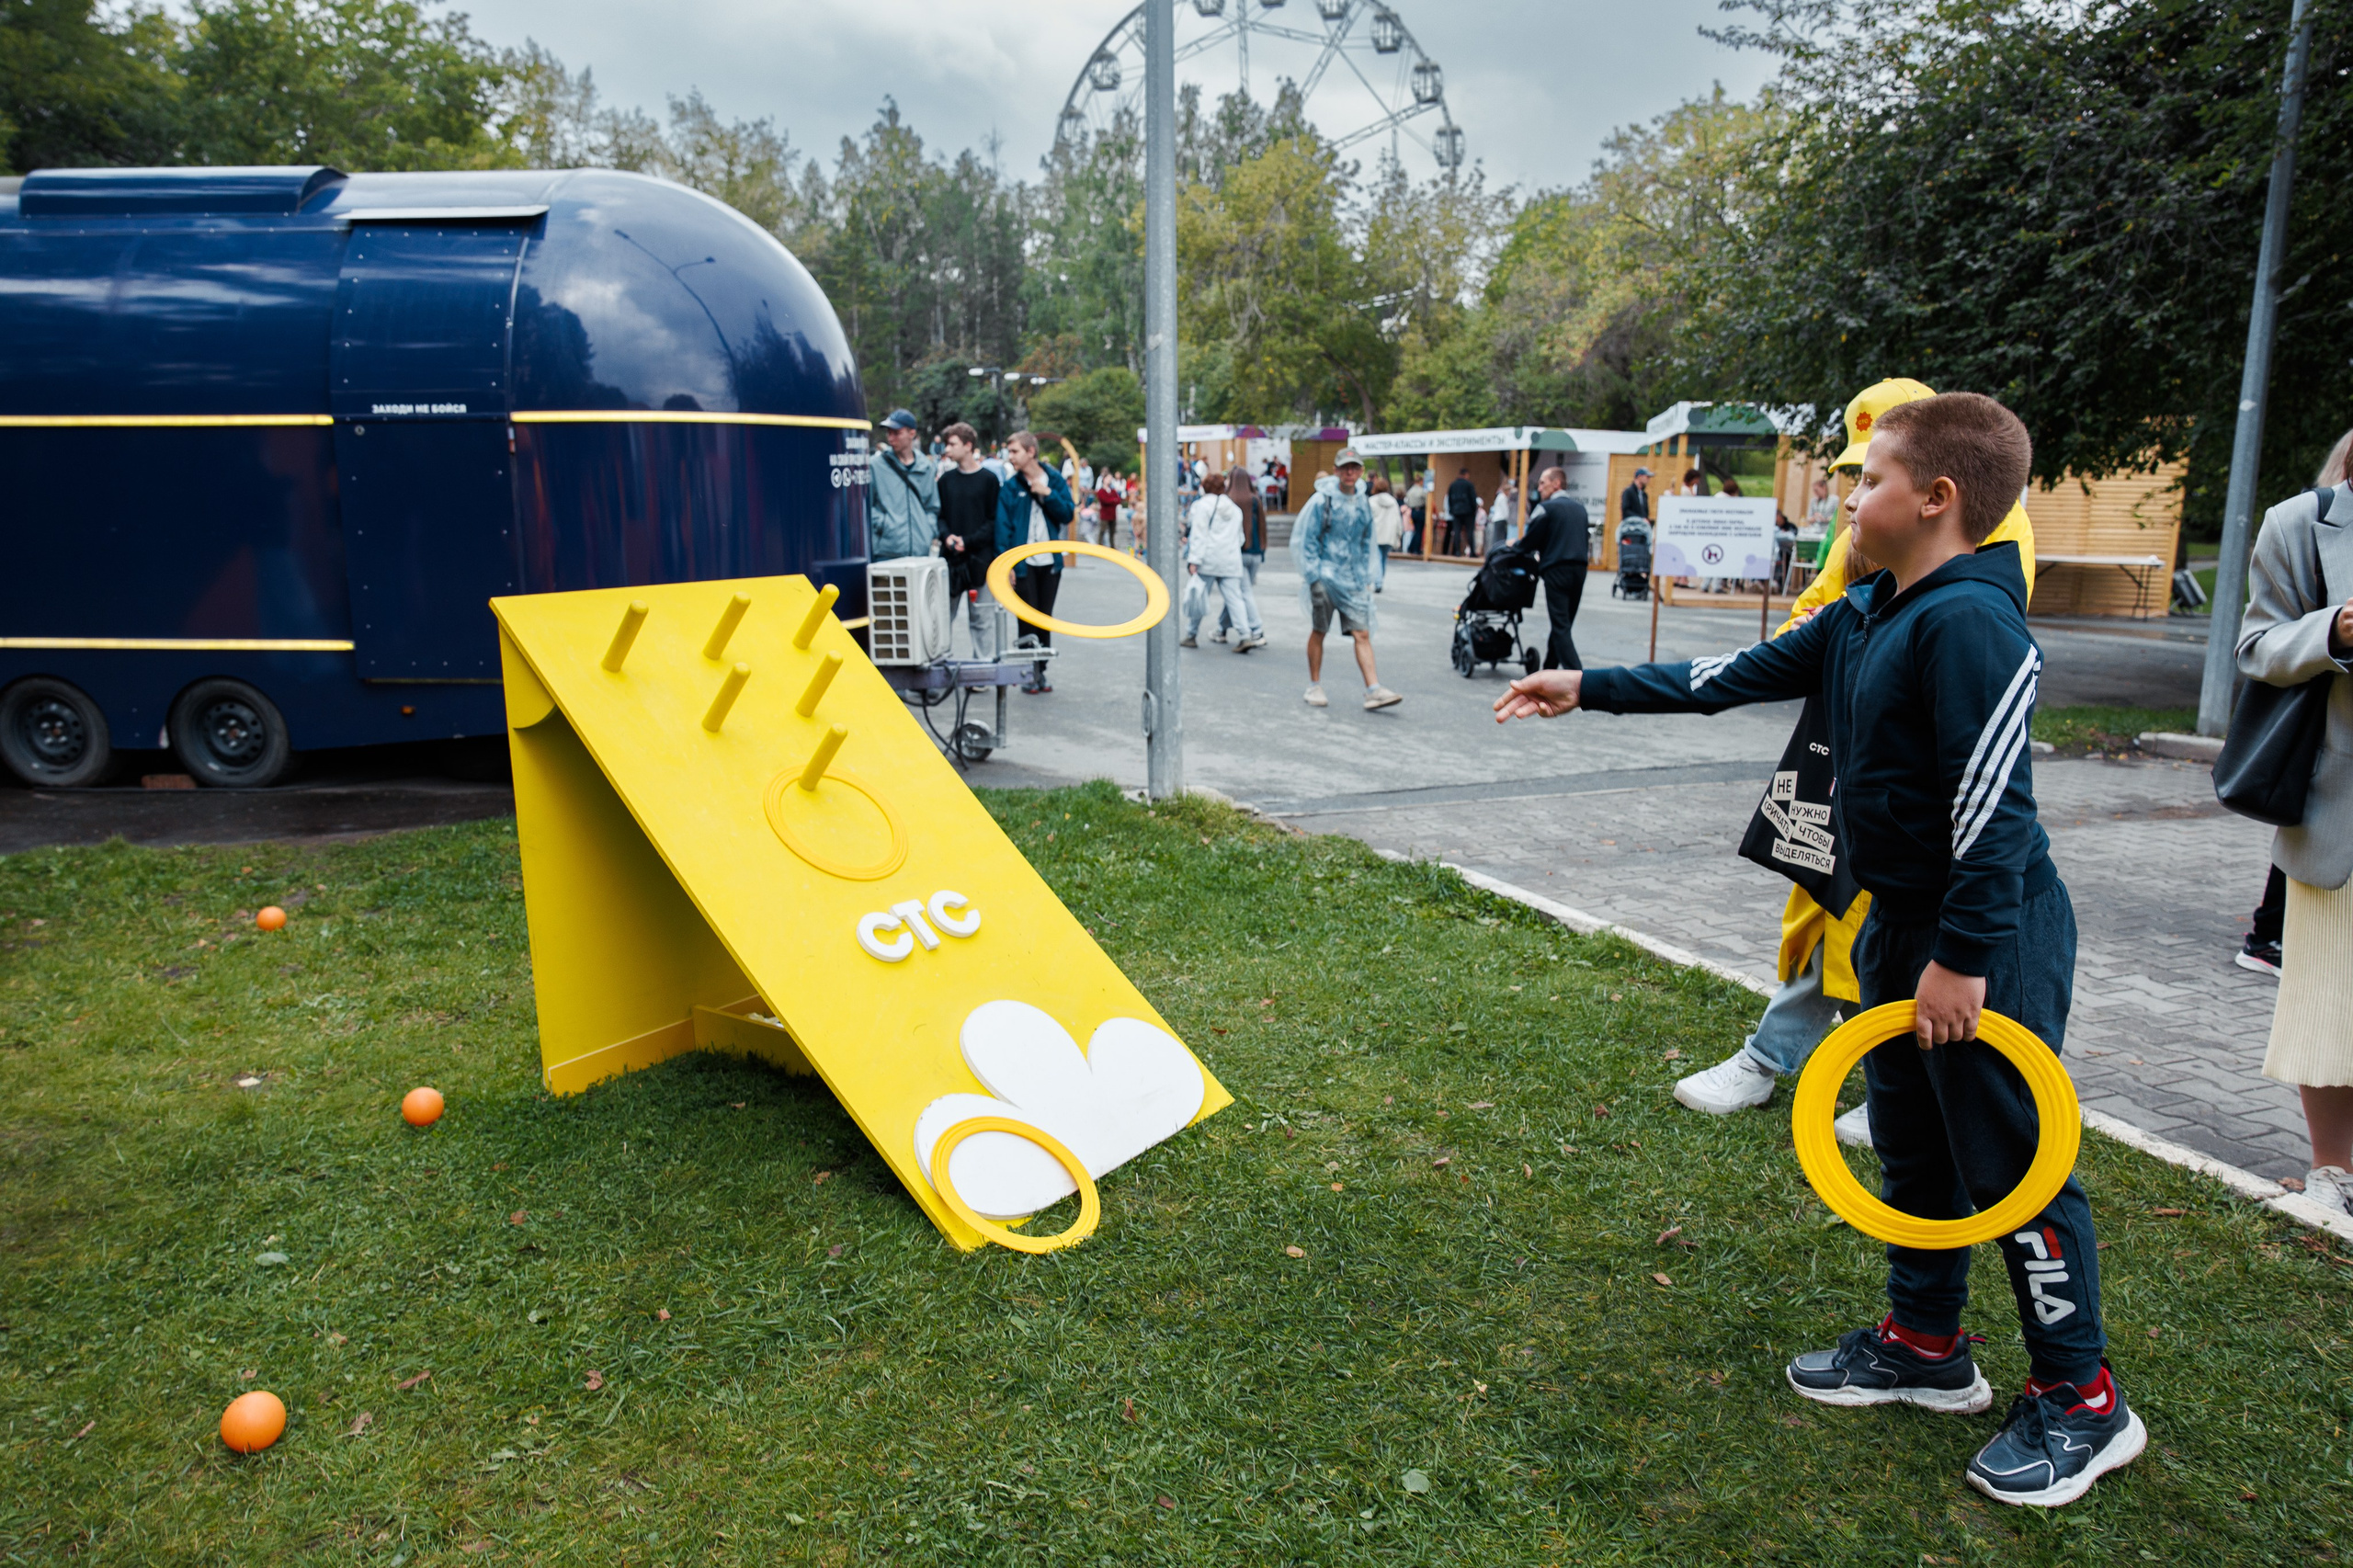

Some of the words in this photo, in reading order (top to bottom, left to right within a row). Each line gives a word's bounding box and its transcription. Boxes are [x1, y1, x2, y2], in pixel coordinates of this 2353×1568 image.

[371, 403, 414, 415] ЗАХОДИ
[415, 403, 429, 414] НЕ
[430, 402, 467, 414] БОЙСЯ
[1437, 436, 1506, 449] ЭКСПЕРИМЕНТЫ
[1809, 742, 1830, 756] СТС
[1777, 778, 1792, 793] НЕ
[1791, 804, 1827, 821] НУЖНО
[1799, 827, 1830, 849] ЧТОБЫ
[1775, 843, 1831, 869] ВЫДЕЛЯТЬСЯ
[856, 890, 981, 962] СТС
[2015, 1226, 2076, 1324] FILA
